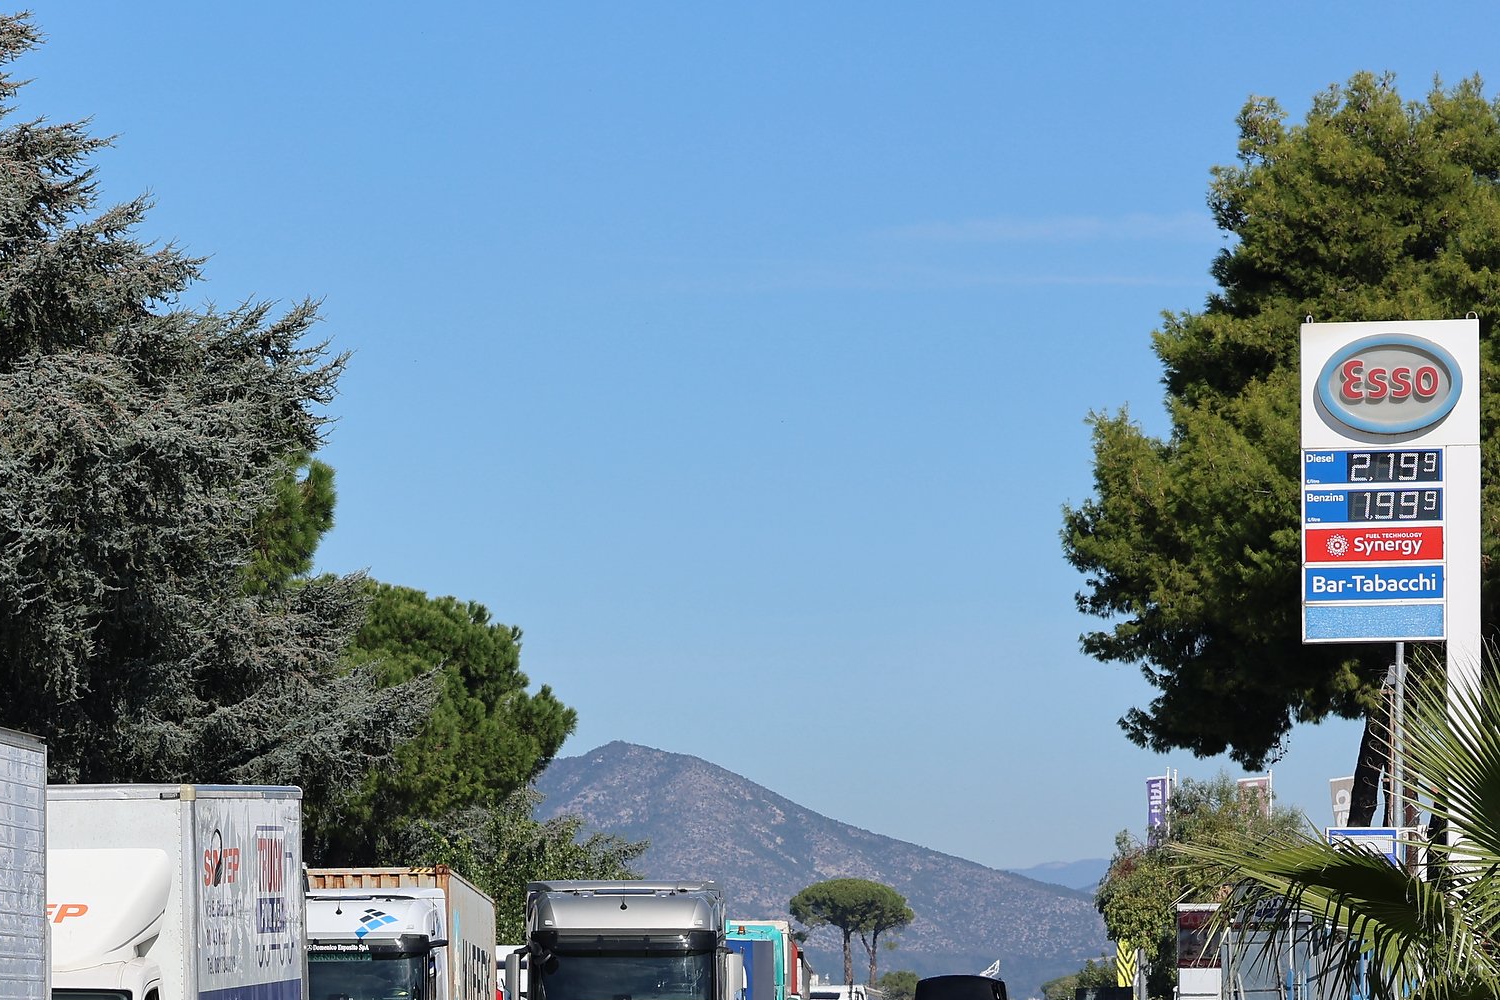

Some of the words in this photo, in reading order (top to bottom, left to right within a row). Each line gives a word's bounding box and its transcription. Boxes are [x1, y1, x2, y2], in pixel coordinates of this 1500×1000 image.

[1305, 453, 1334, 463] Diesel
[1306, 493, 1344, 502] Benzina
[1353, 537, 1423, 556] Synergy
[1312, 573, 1436, 593] Bar-Tabacchi
[257, 838, 283, 893] TRUCK
